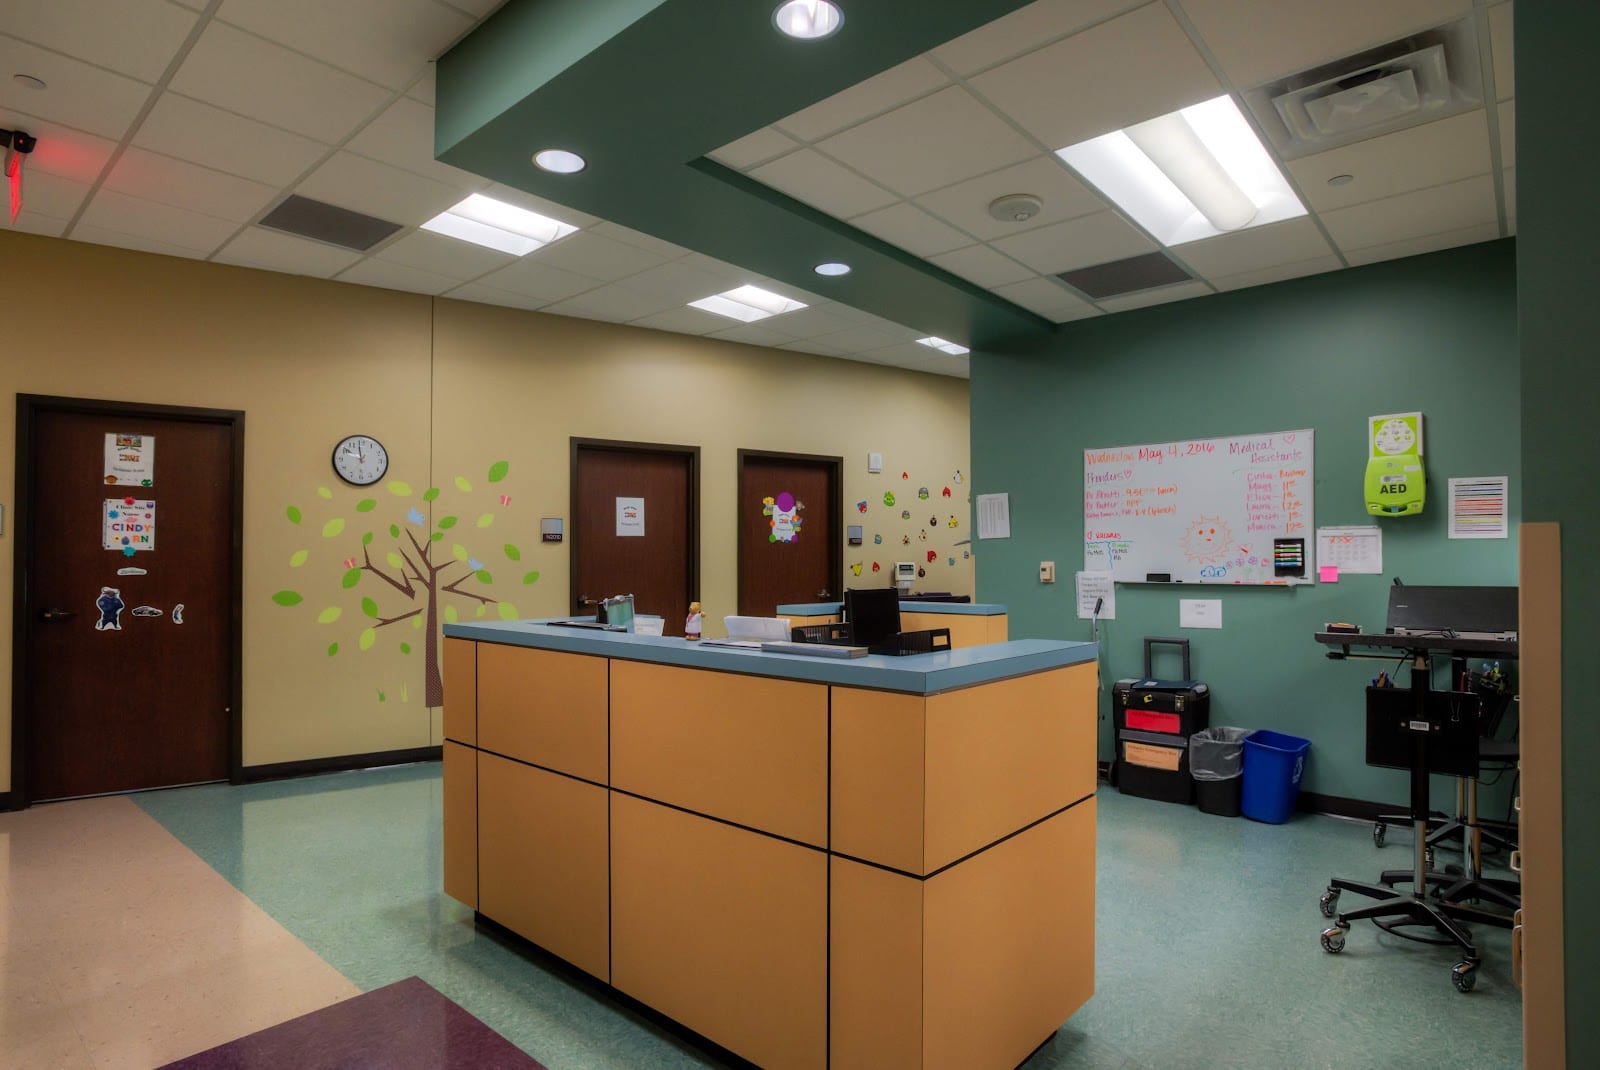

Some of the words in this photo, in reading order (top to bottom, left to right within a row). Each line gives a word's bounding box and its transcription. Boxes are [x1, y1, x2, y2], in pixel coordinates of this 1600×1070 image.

[1138, 447, 1163, 464] May
[1186, 442, 1215, 455] 2016
[1229, 438, 1273, 456] Medical
[1379, 483, 1407, 495] AED
[112, 523, 151, 532] CINDY
[133, 535, 149, 543] RN
